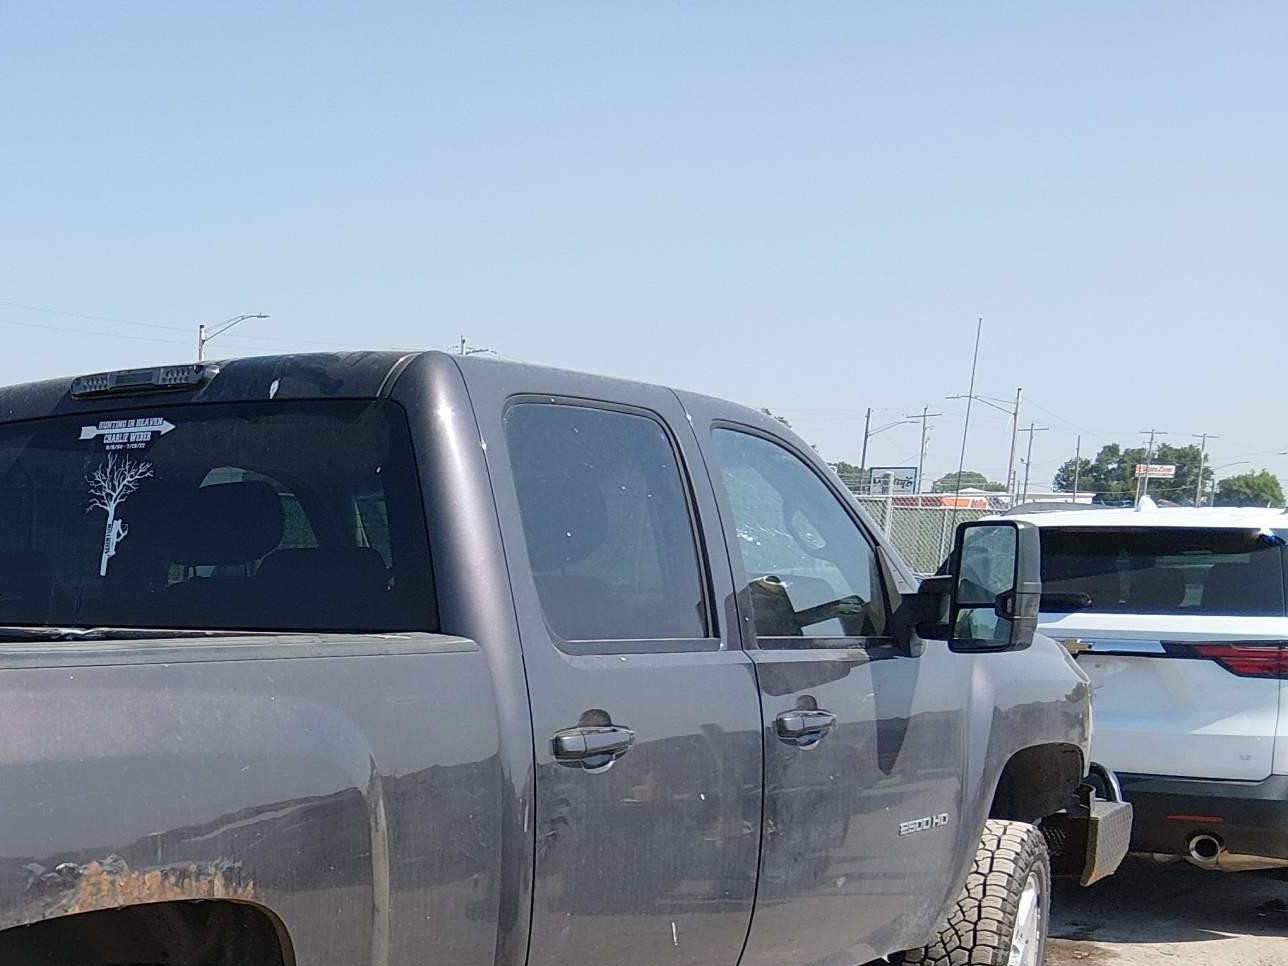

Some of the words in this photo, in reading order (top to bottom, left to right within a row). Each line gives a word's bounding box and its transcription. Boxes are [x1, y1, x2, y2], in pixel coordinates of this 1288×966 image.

[136, 417, 164, 427] HEAVEN
[103, 433, 129, 444] CHARLIE
[900, 816, 931, 835] 2500
[932, 813, 948, 828] HD
